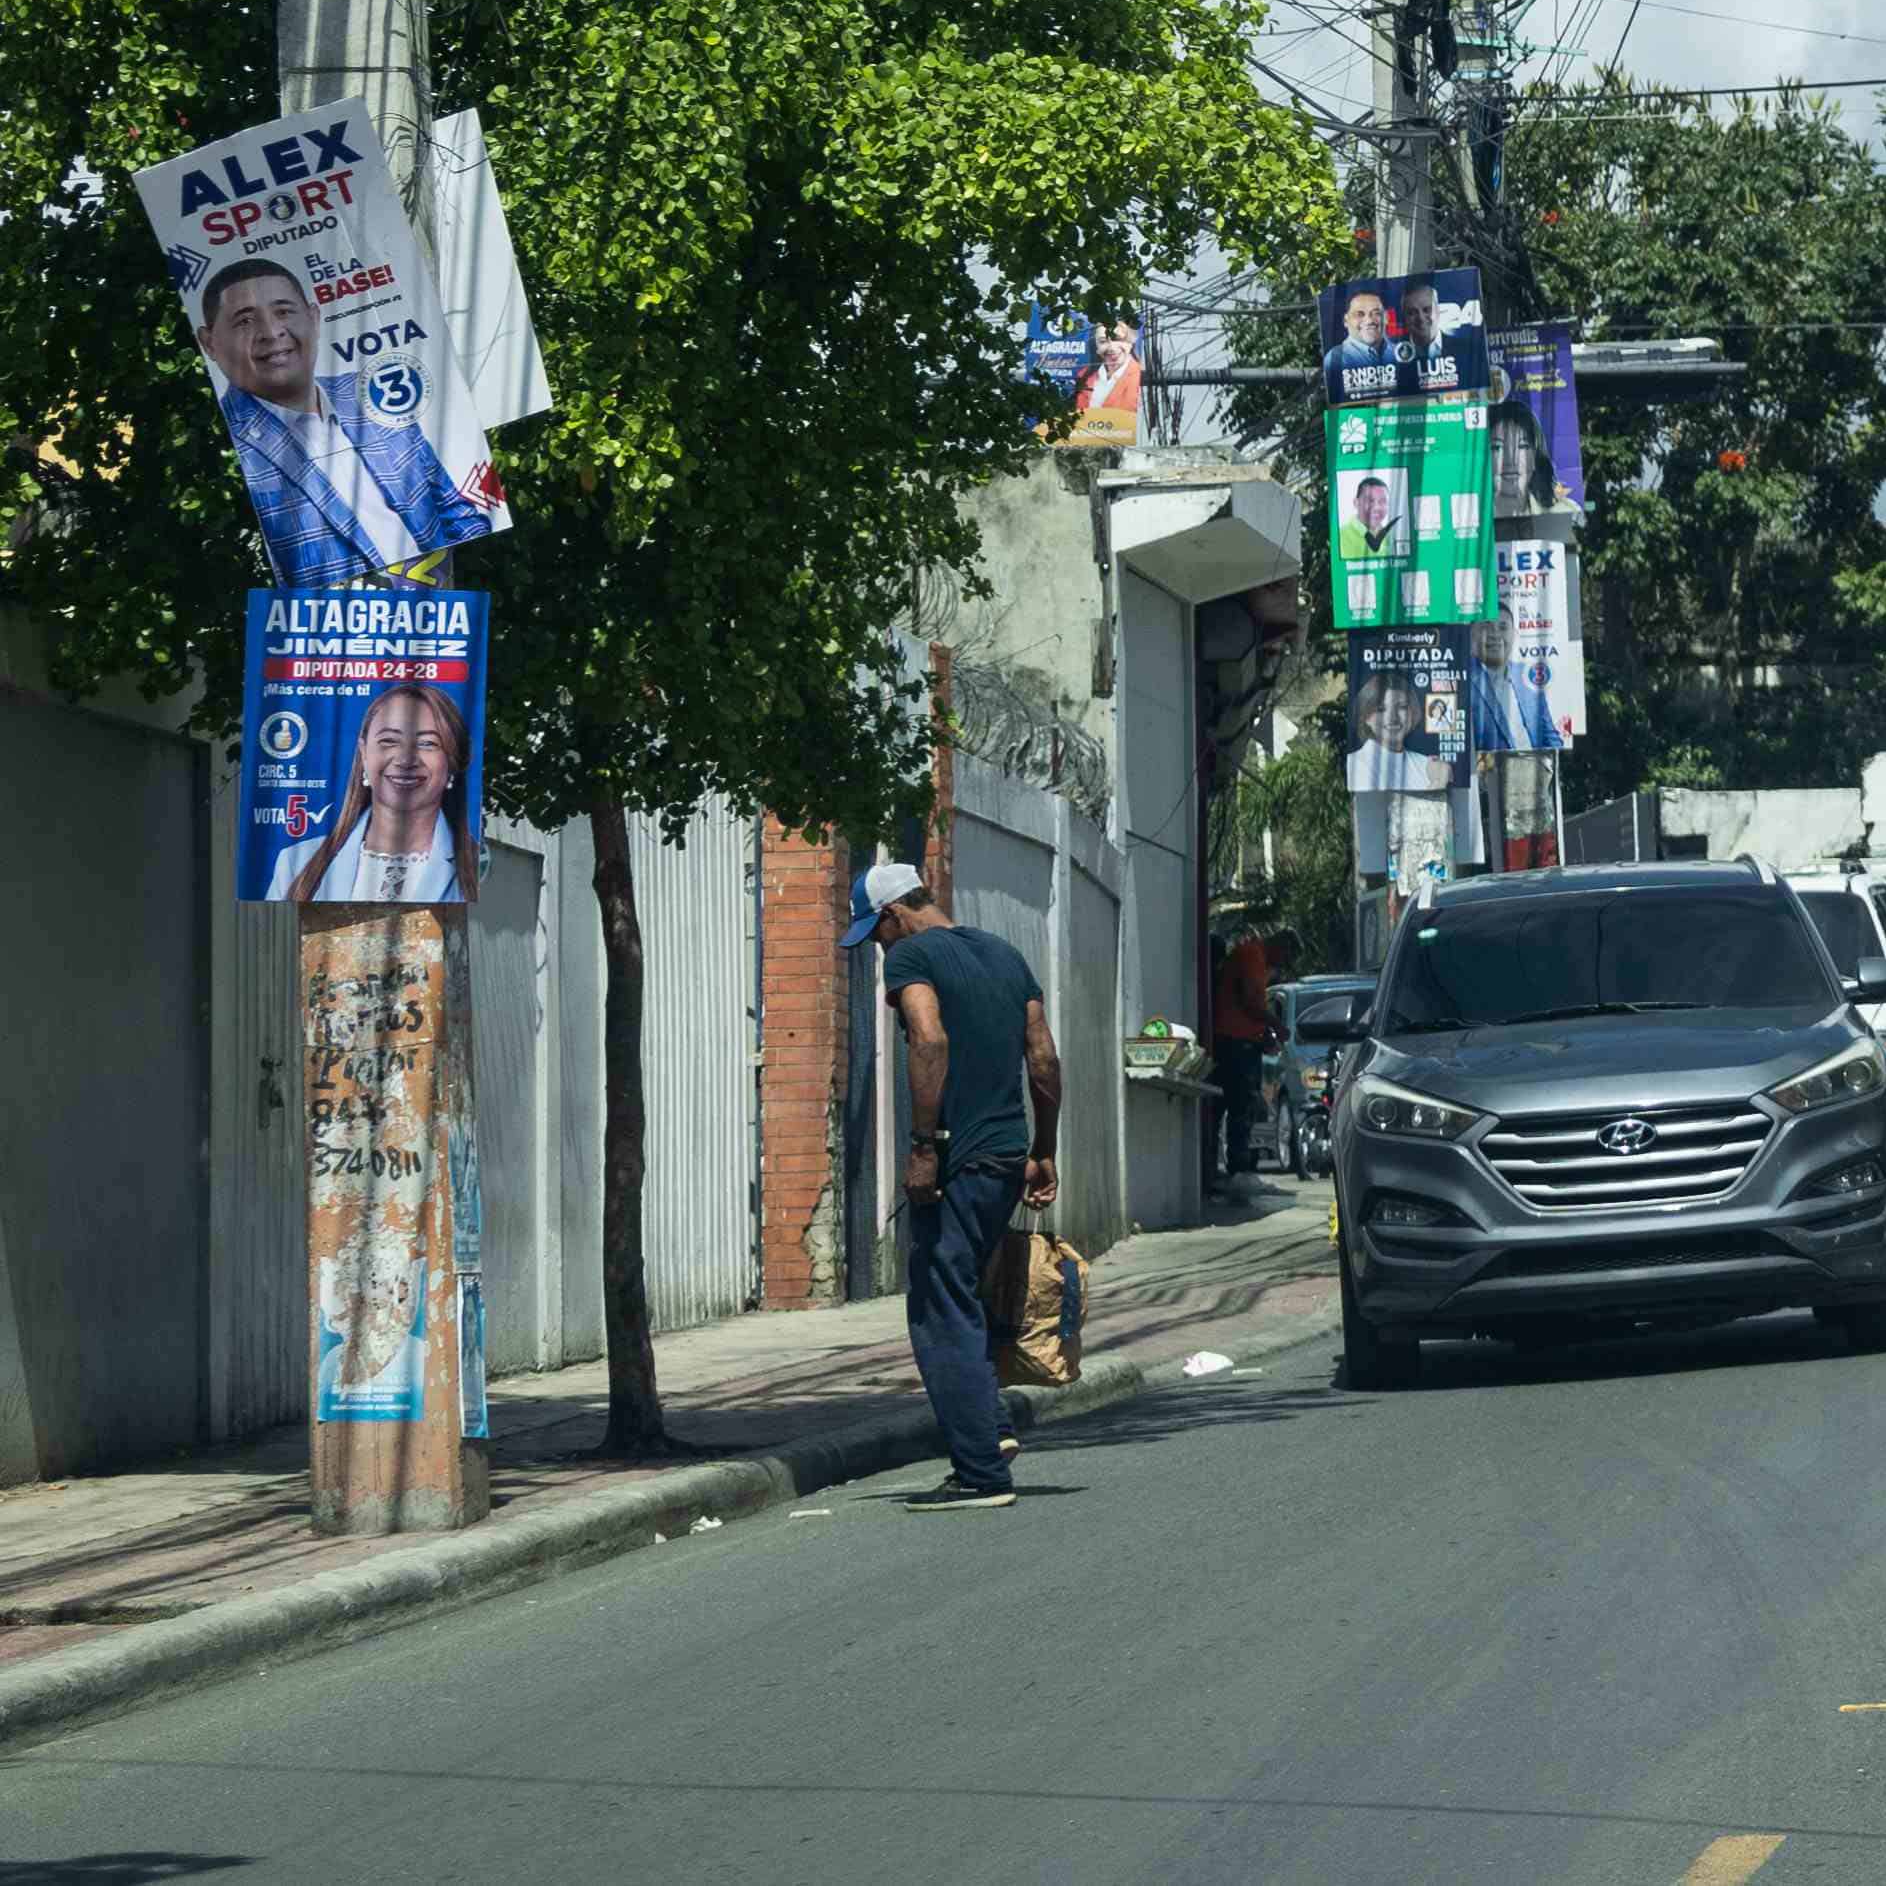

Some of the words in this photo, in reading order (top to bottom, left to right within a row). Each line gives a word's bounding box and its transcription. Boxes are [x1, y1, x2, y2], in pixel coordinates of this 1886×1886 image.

[181, 120, 364, 217] ALEX
[243, 216, 338, 255] DIPUTADO
[304, 253, 327, 268] EL
[310, 265, 336, 283] DE
[338, 258, 364, 274] LA
[313, 265, 394, 305] BASE!
[331, 319, 428, 362] VOTA
[1489, 328, 1539, 345] ertrudis
[1417, 356, 1457, 377] LUIS
[377, 366, 415, 410] 3
[1472, 410, 1480, 425] 3
[1342, 444, 1365, 454] FP
[1499, 550, 1554, 571] LEX
[1497, 573, 1549, 588] PORT
[265, 600, 470, 635] ALTAGRACIA
[266, 634, 467, 656] JIMÉNEZ
[1364, 648, 1454, 662] DIPUTADA
[1520, 646, 1559, 657] VOTA
[293, 662, 378, 678] DIPUTADA
[383, 663, 438, 679] 24-28
[264, 683, 293, 697] ¡Más
[297, 685, 333, 695] cerca
[337, 684, 353, 695] de
[259, 764, 286, 778] CIRC.
[289, 764, 296, 778] 5
[254, 808, 286, 824] VOTA
[287, 795, 308, 837] 5
